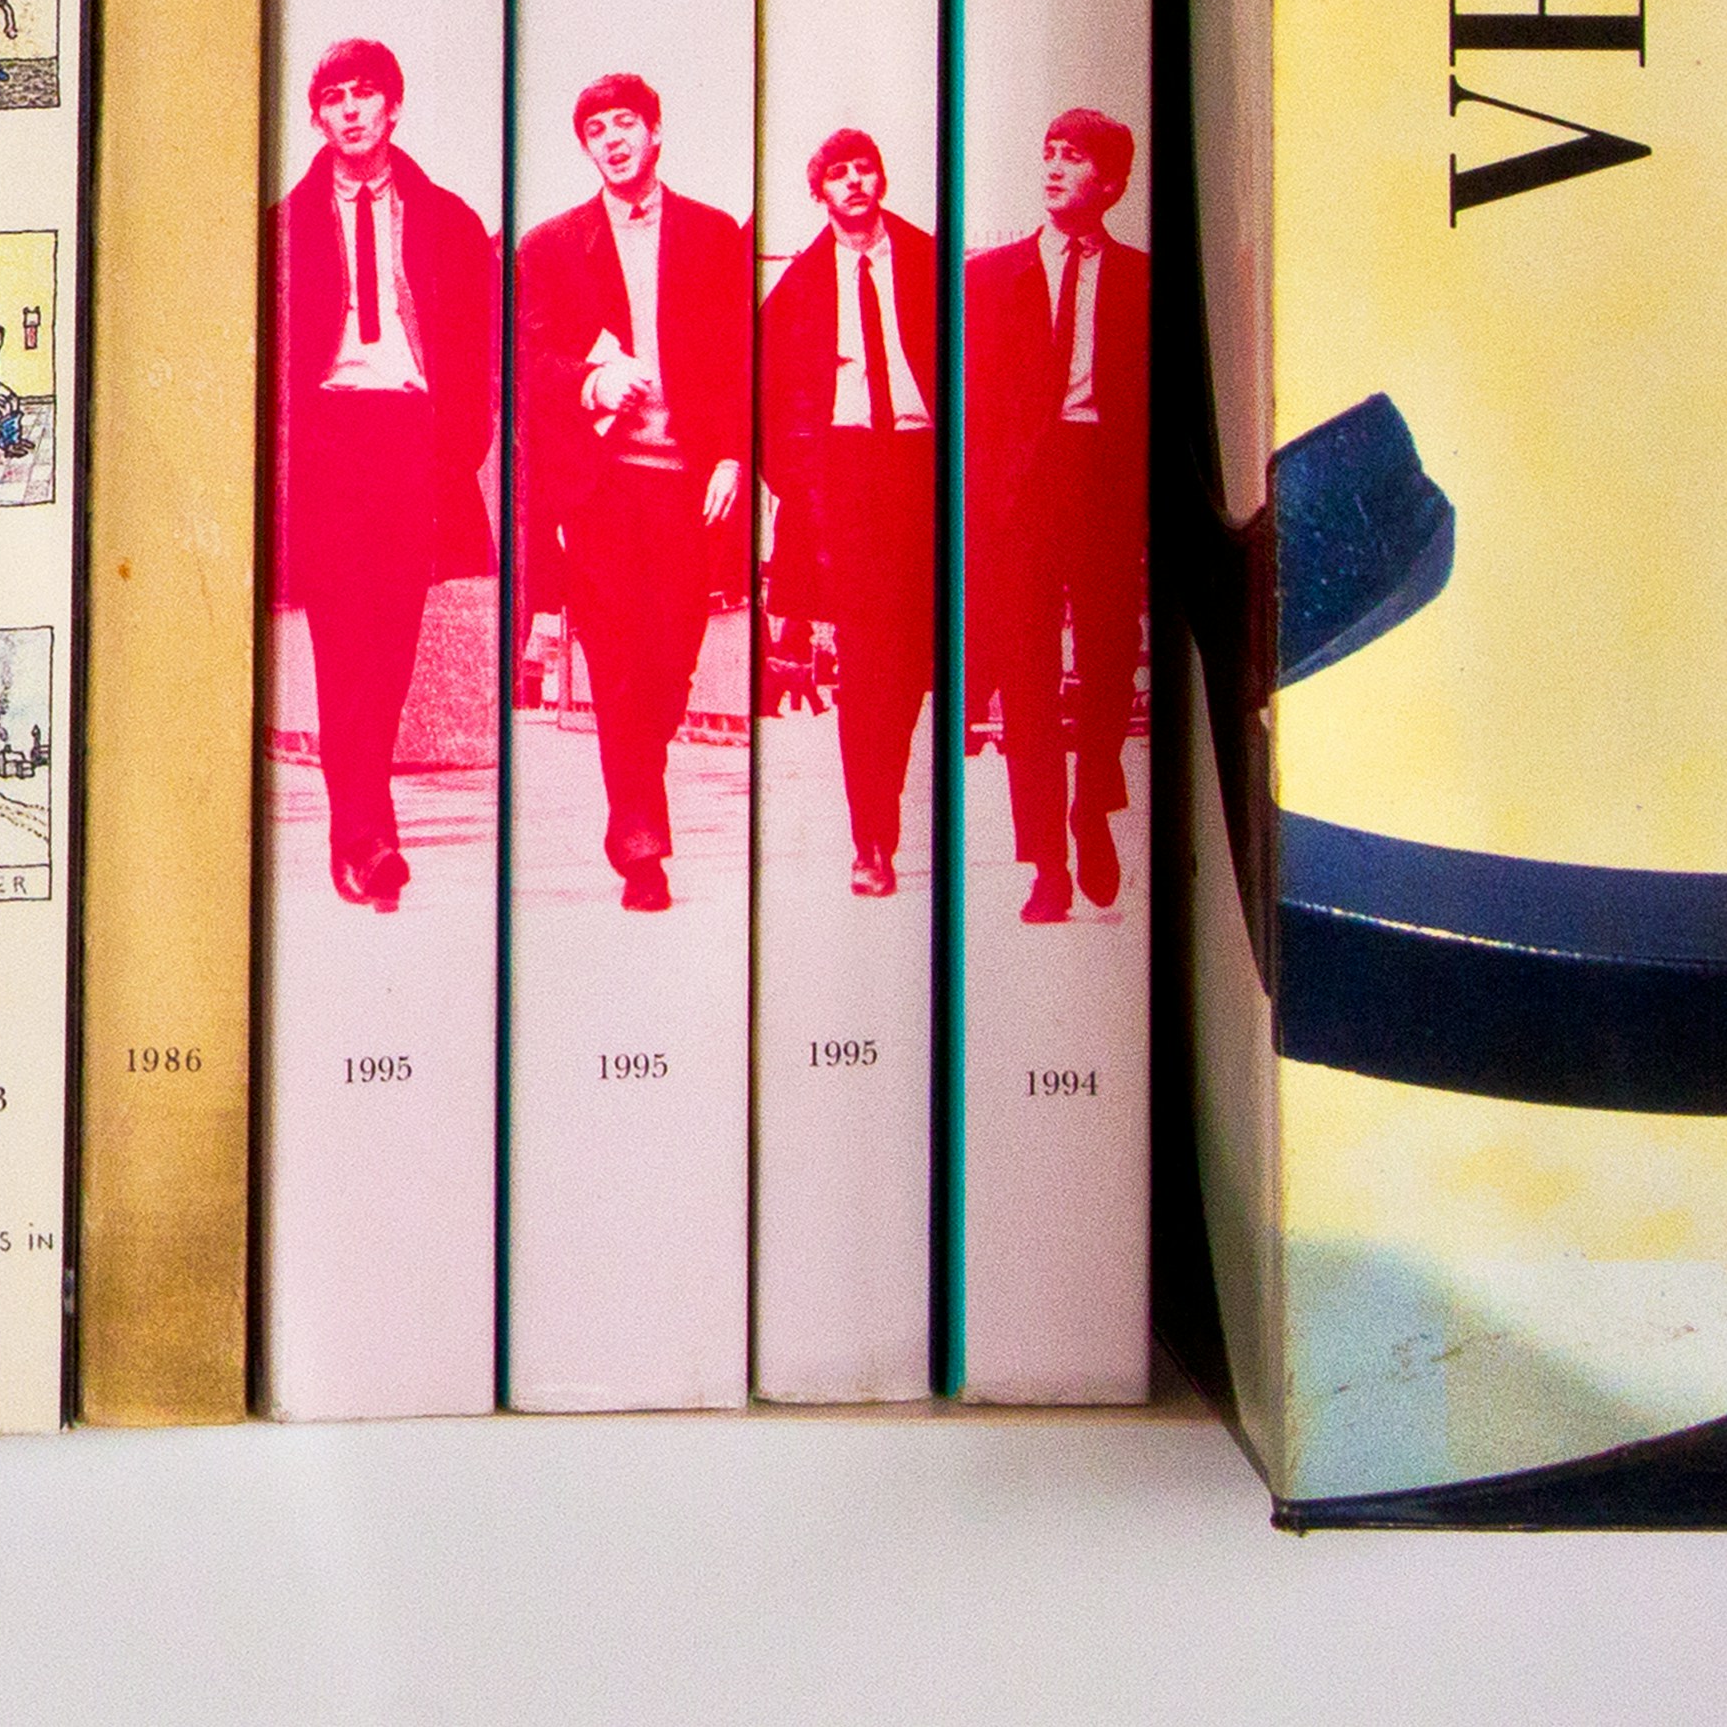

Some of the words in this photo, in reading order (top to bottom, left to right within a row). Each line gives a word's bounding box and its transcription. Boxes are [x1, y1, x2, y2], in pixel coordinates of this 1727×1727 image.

[128, 1048, 203, 1073] 1986
[600, 1053, 669, 1080] 1995
[810, 1040, 879, 1068] 1995
[346, 1055, 413, 1084] 1995
[1028, 1070, 1098, 1097] 1994
